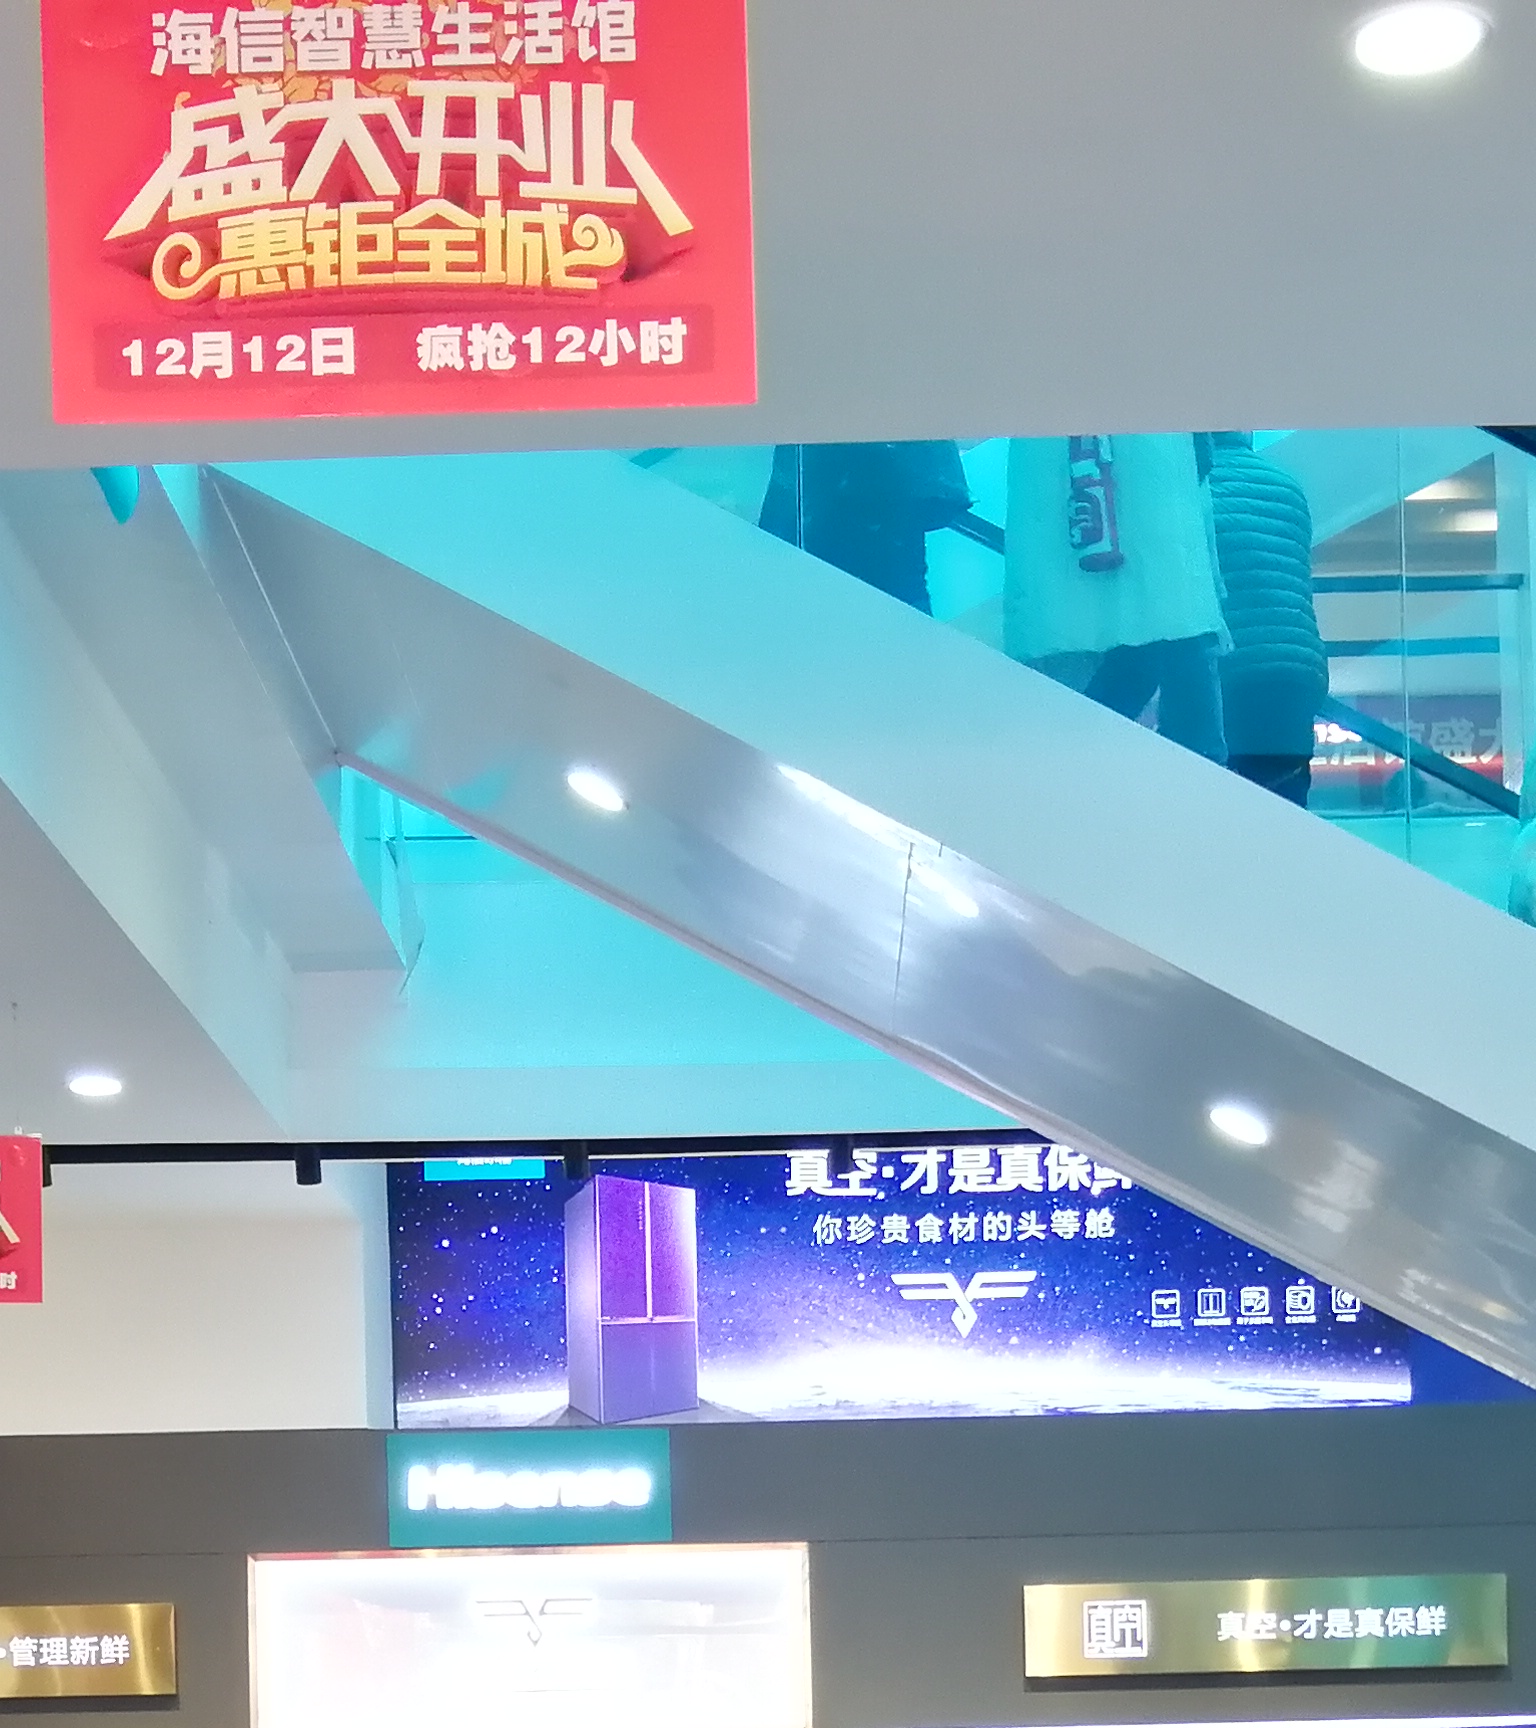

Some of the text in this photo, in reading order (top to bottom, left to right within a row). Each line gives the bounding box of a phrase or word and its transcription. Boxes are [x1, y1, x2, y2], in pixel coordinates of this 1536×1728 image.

[150, 0, 638, 76] 海信智慧生活馆
[103, 78, 695, 241] 盛大开业
[151, 198, 627, 301] 惠钜全城
[120, 315, 689, 379] 12月12日 疯抢12小时
[812, 1206, 1117, 1246] 你珍贵食材的头等舱
[1216, 1604, 1449, 1642] 真空·才是真保鲜
